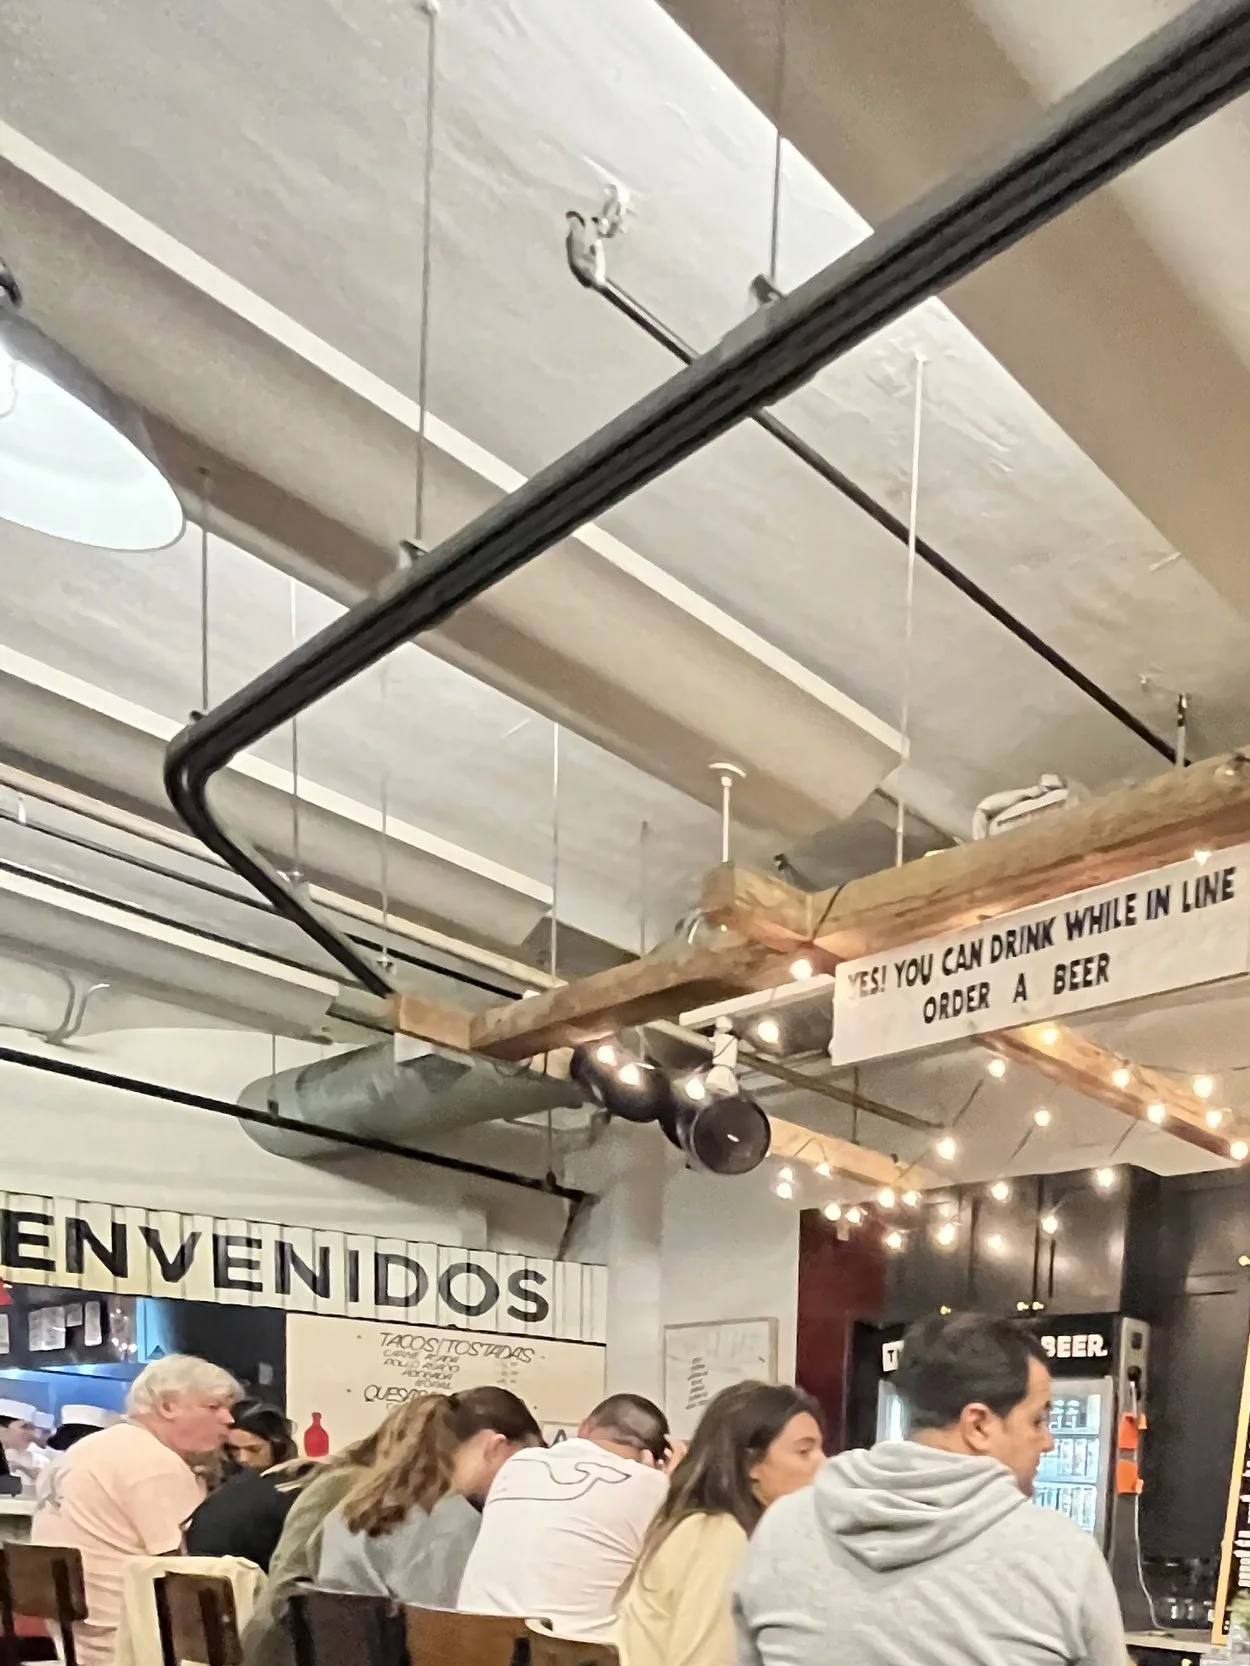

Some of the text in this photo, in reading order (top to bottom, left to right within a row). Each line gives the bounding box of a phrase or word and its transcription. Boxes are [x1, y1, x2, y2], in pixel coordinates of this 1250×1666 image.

[848, 866, 1237, 998] YES! YOU CAN DRINK WHILE IN LINE
[923, 952, 1110, 1024] ORDER A BEER
[0, 1209, 549, 1323] ENVENIDOS
